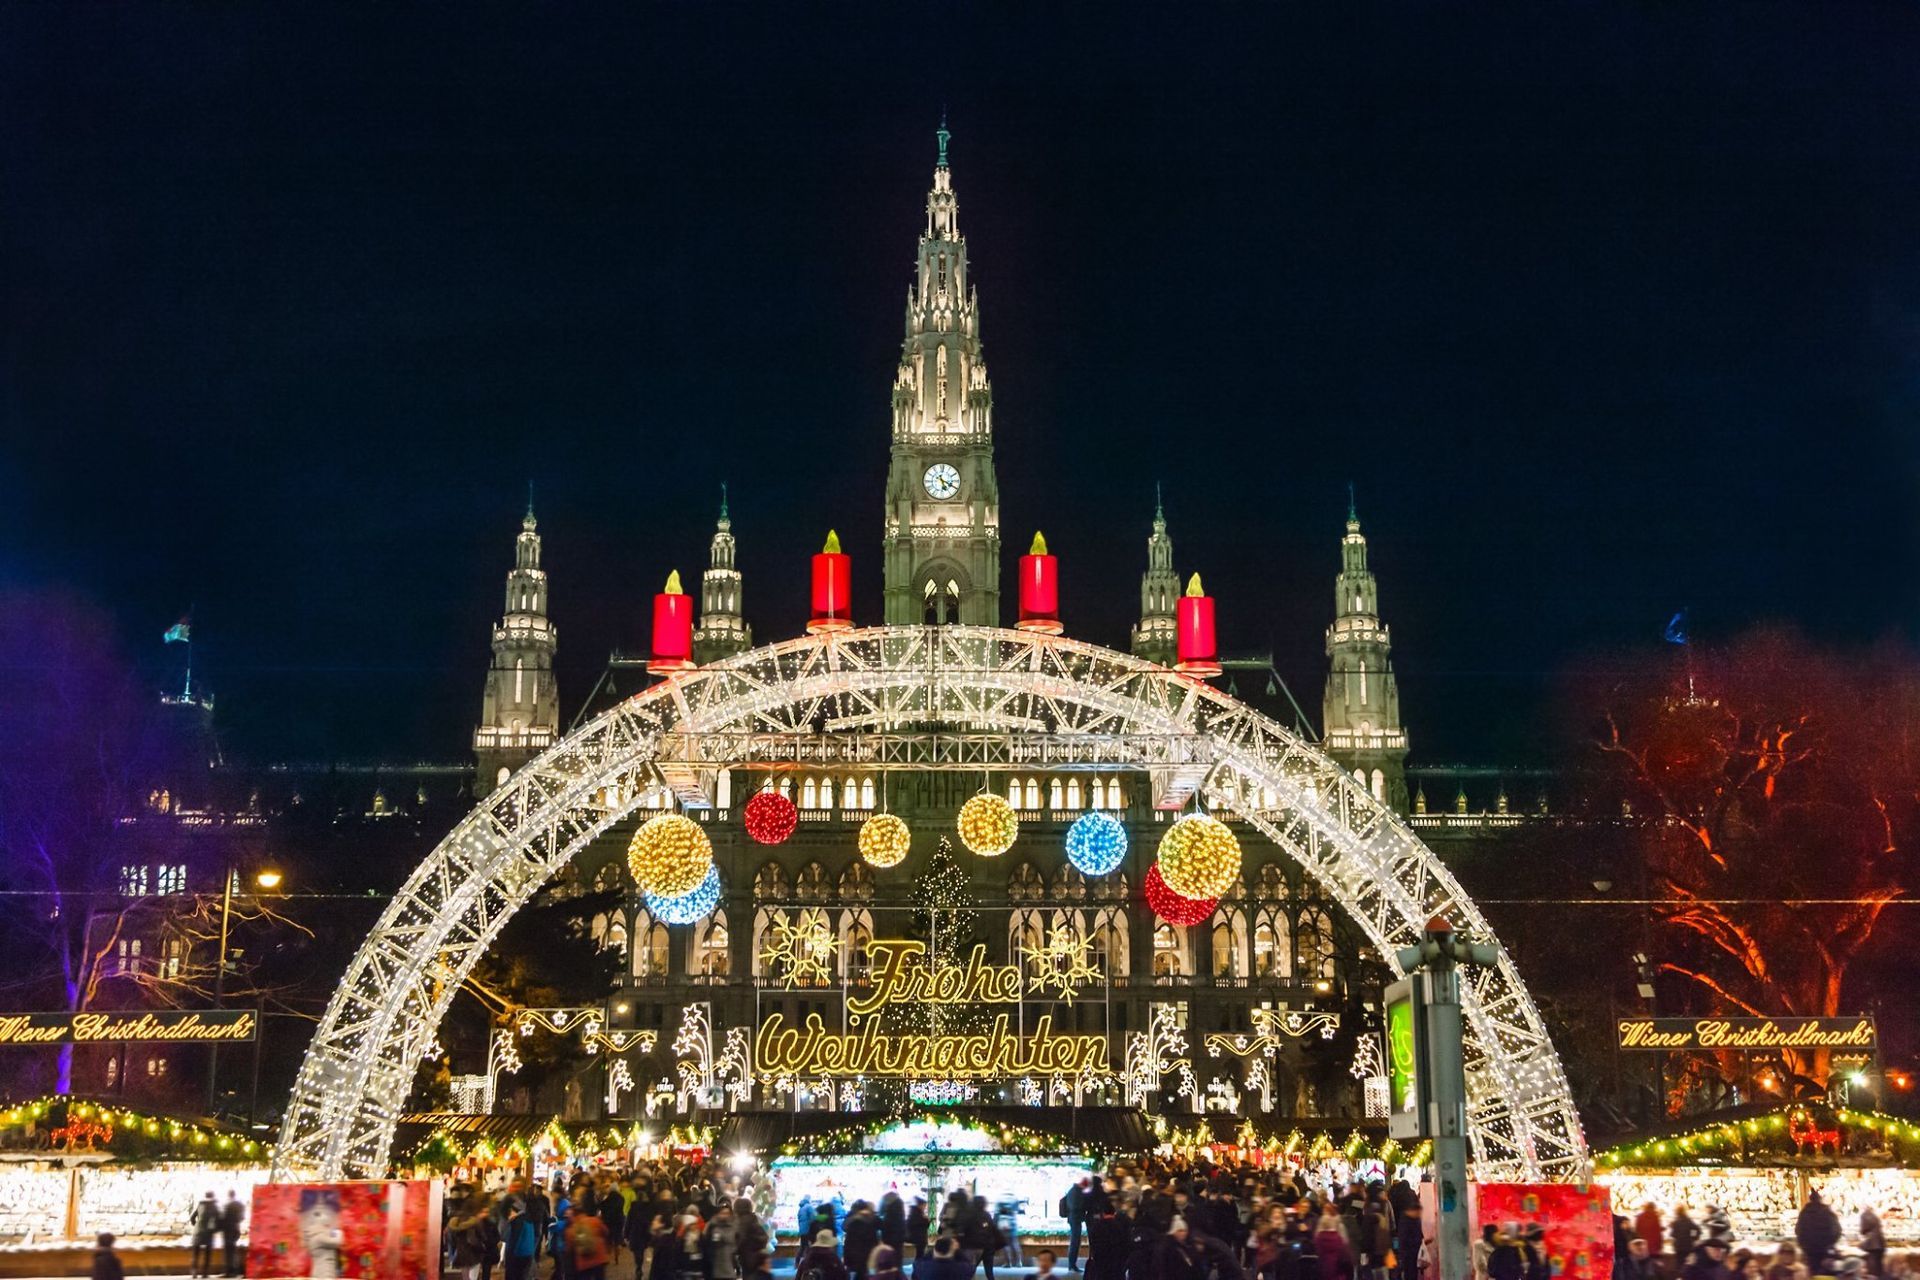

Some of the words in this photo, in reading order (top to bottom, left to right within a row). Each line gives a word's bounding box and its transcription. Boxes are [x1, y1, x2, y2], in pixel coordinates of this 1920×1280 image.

[847, 940, 1022, 1014] Frohe
[0, 1015, 68, 1043] Wiener
[72, 1013, 255, 1042] Christkindlmarkt
[756, 1013, 1110, 1075] Weihnachten
[1619, 1021, 1692, 1047] Wiener
[1695, 1020, 1874, 1047] Christkindlmarkt
